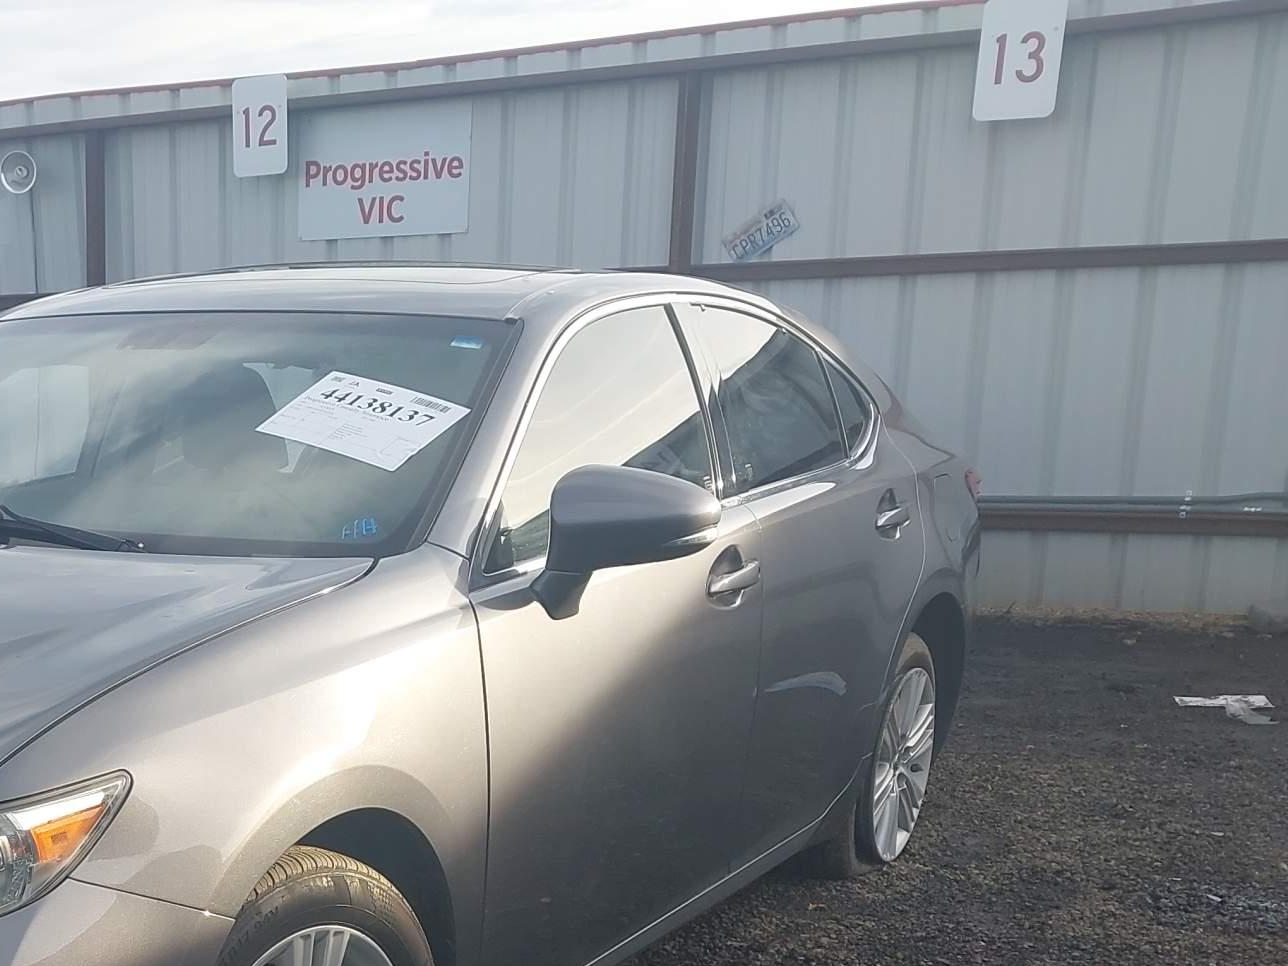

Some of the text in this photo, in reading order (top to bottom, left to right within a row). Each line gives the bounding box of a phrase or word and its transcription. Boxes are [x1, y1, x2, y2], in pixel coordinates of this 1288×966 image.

[993, 30, 1047, 86] 13
[242, 103, 278, 149] 12
[304, 150, 465, 191] Progressive
[357, 194, 406, 225] VIC
[731, 211, 791, 260] CPR7496
[320, 388, 436, 427] 44138137
